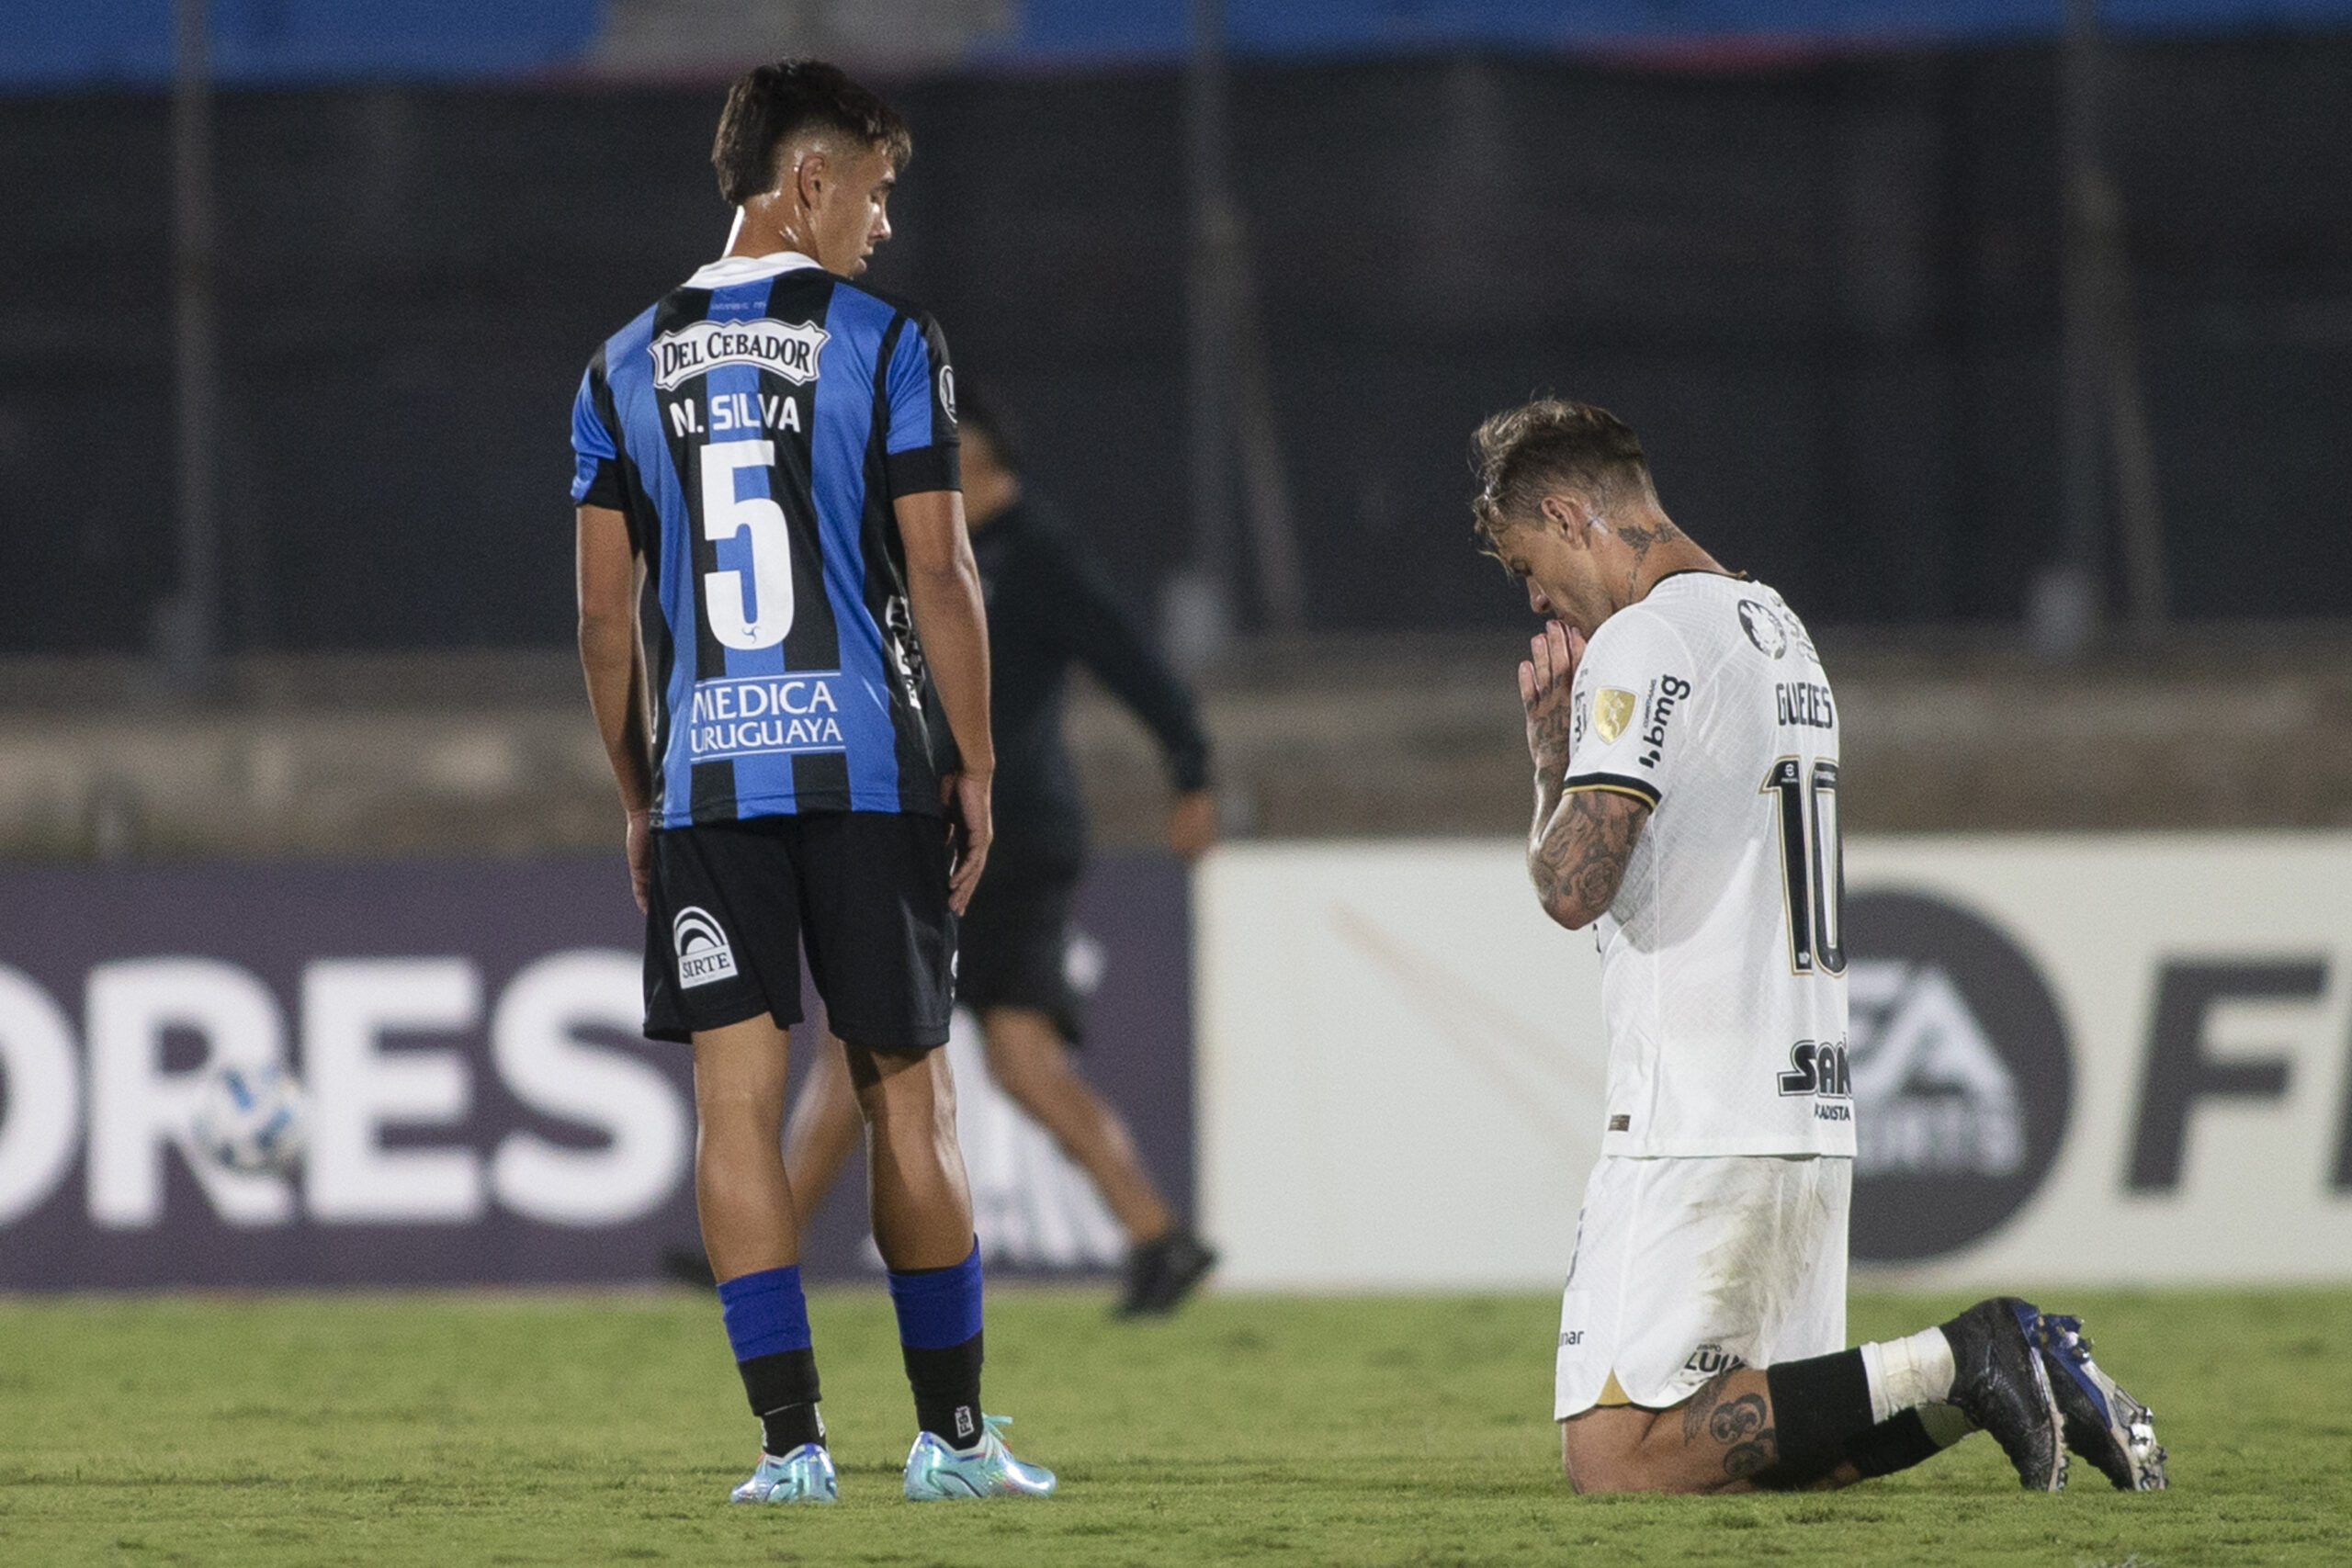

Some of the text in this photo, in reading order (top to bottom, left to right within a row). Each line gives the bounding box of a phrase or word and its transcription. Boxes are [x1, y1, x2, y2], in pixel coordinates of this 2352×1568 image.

[662, 332, 811, 378] DEL CEBADOR
[669, 392, 801, 438] N. SILVA
[700, 439, 795, 650] 5
[691, 680, 838, 724] MEDICA
[1643, 673, 1691, 749] bmg
[690, 717, 844, 753] URUGUAYA
[1758, 755, 1848, 979] 10
[682, 952, 730, 979] SIRTE
